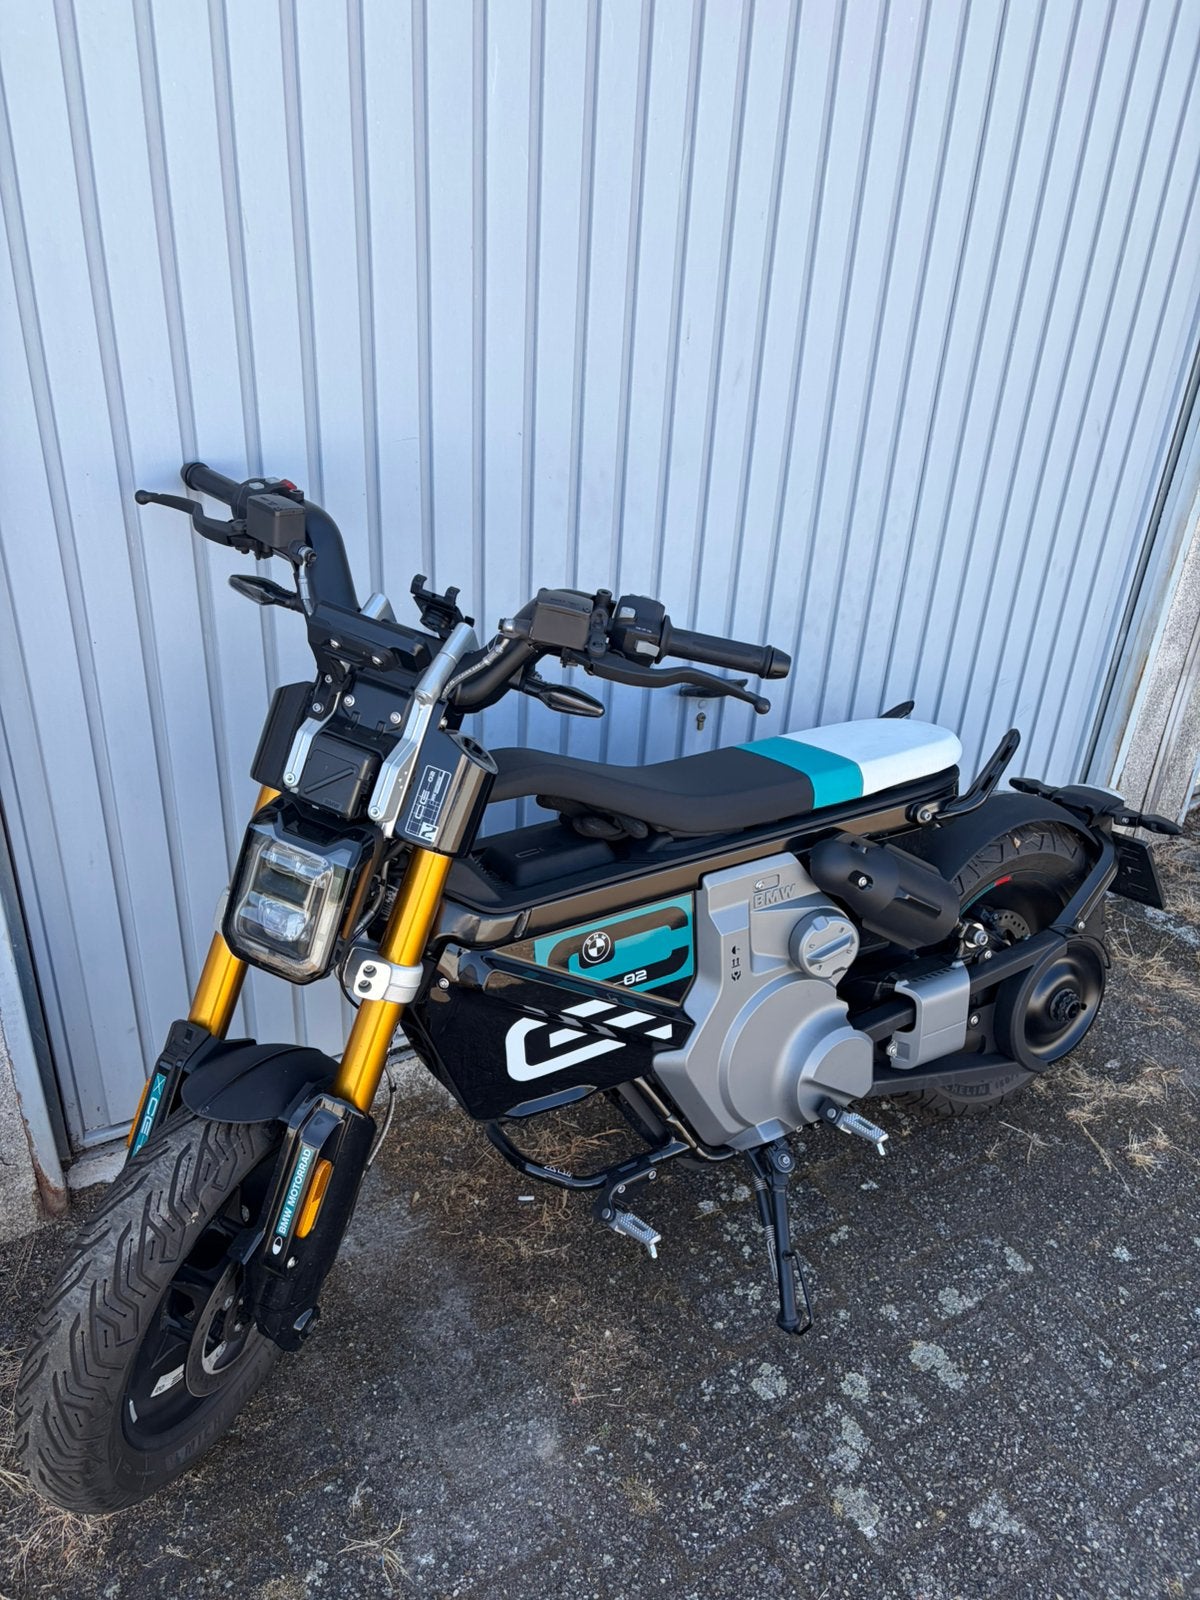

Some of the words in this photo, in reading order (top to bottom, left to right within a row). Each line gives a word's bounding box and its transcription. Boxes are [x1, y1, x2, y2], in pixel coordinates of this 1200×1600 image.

[753, 884, 796, 911] BMW
[278, 1208, 295, 1235] BMW
[287, 1148, 312, 1208] MOTORRAD
